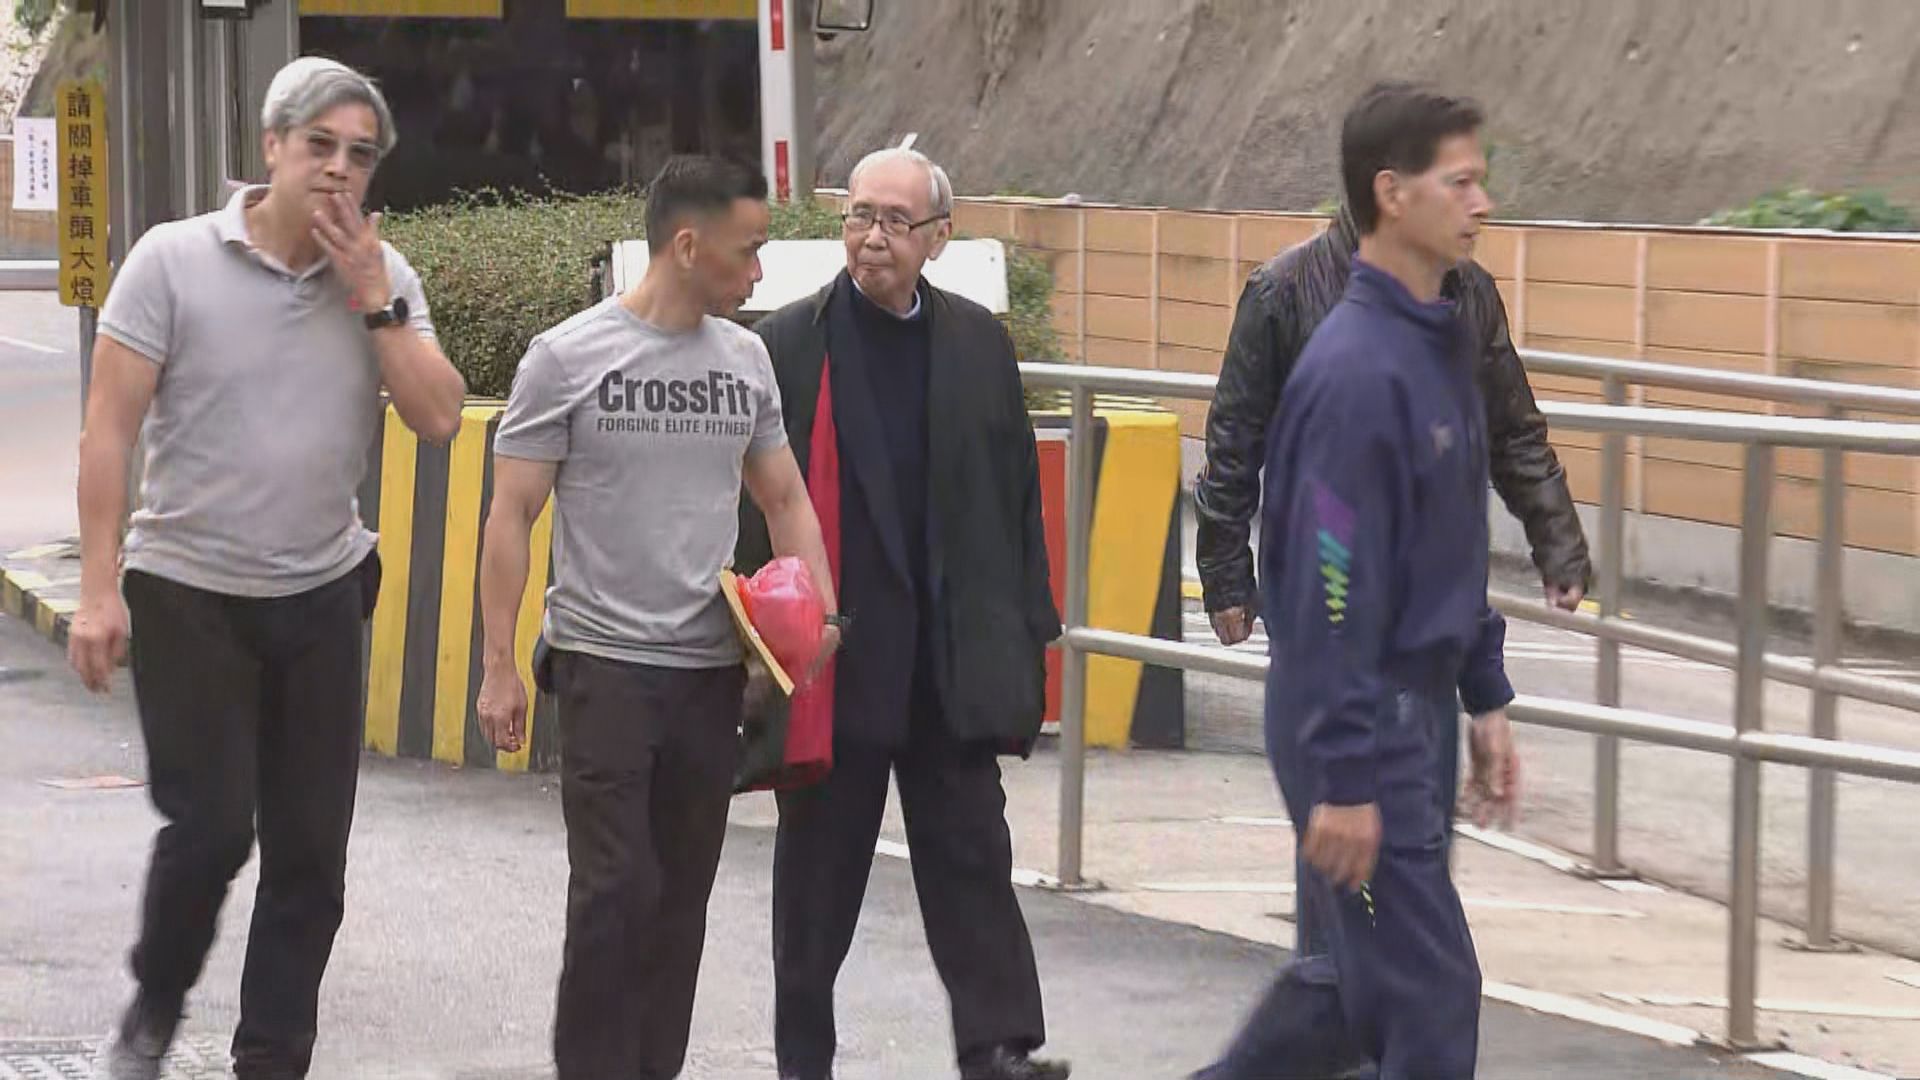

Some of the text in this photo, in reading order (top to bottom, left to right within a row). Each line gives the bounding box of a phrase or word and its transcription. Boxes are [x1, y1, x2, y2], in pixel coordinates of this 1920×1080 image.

[67, 91, 94, 301] 請關掉車頭大燈
[598, 370, 750, 416] CrossFit
[598, 417, 659, 433] FORGING
[666, 418, 700, 434] ELITE
